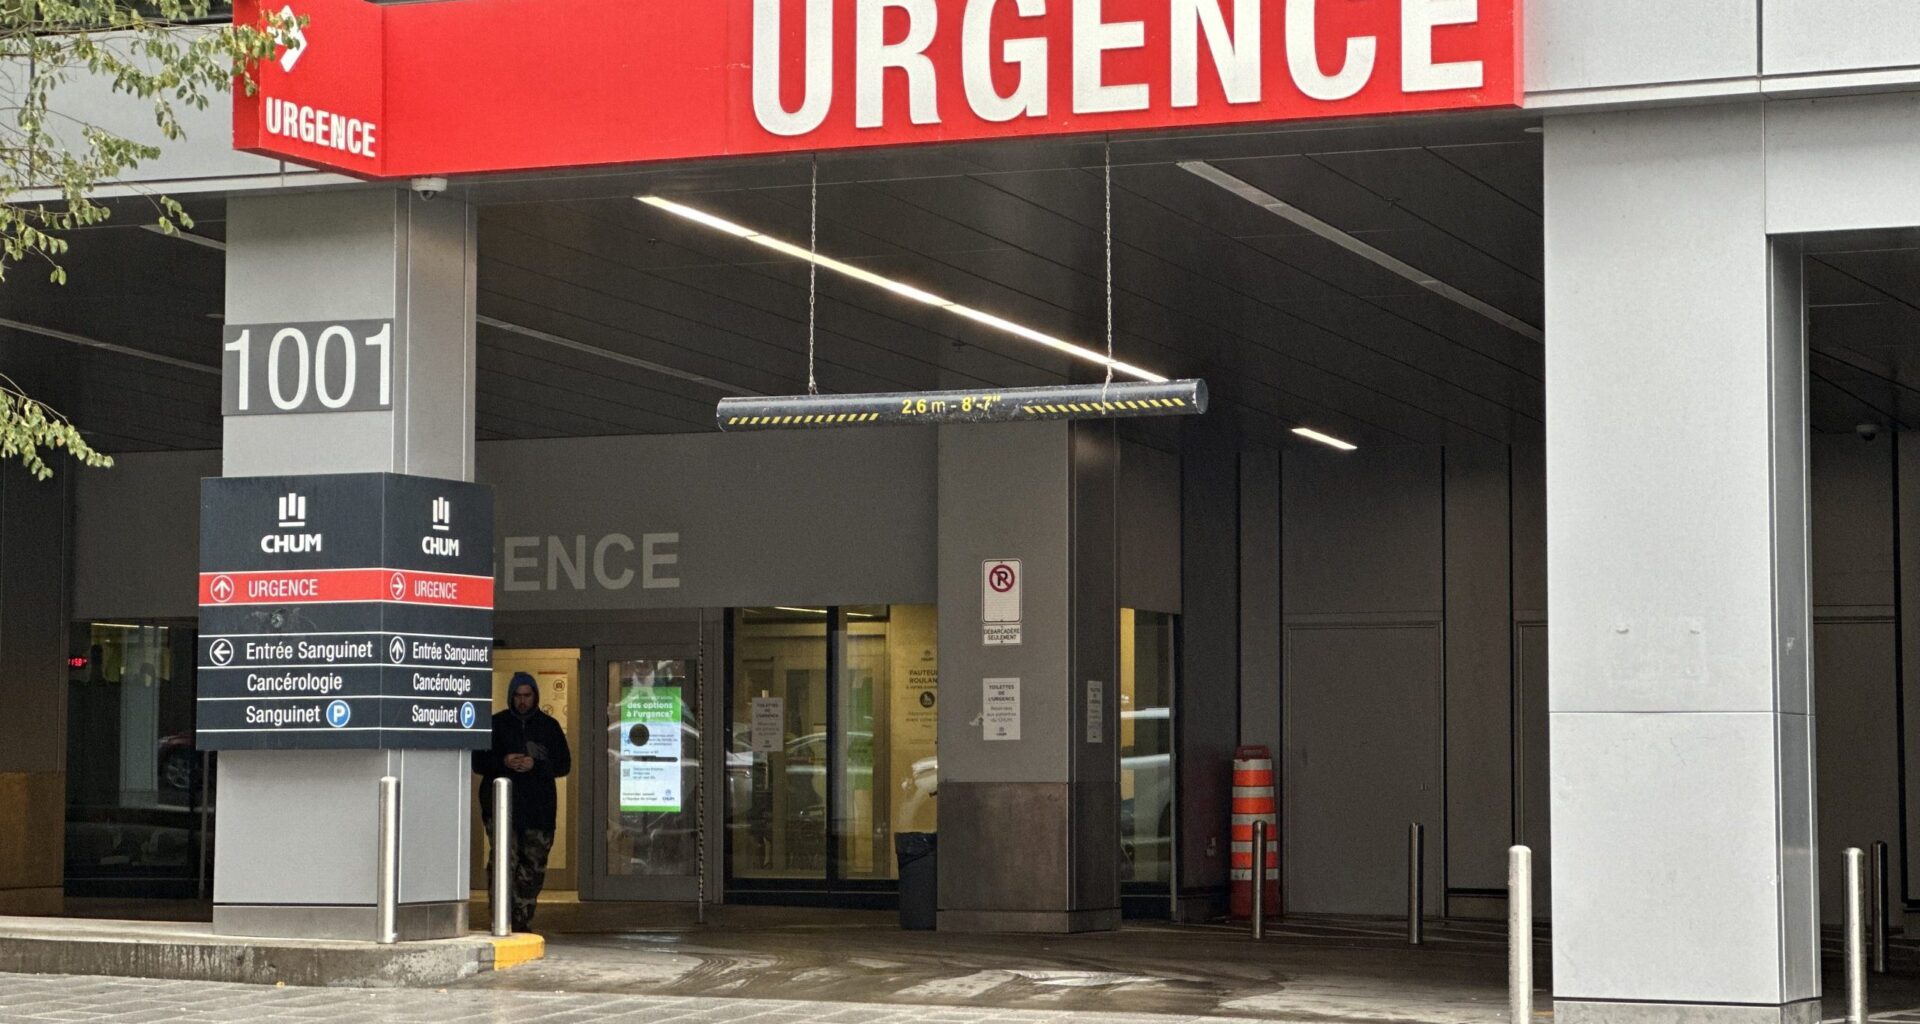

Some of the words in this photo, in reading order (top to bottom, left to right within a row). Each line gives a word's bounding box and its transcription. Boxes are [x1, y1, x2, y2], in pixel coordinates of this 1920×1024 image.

[752, 0, 1485, 137] URGENCE
[265, 97, 376, 159] URGENCE
[225, 322, 391, 411] 1001
[902, 398, 926, 415] 2,6
[931, 401, 946, 413] m
[260, 533, 322, 553] CHUM
[421, 536, 460, 557] CHUM
[493, 532, 680, 592] ENCE
[247, 578, 319, 598] URGENCE
[414, 580, 457, 600] URGENCE
[246, 641, 293, 660] Entrée
[297, 641, 373, 662] Sanguinet
[412, 641, 442, 661] Entrée
[444, 643, 488, 665] Sanguinet
[247, 673, 343, 697] Cancérologie
[412, 673, 471, 695] Cancérologie
[246, 704, 321, 726] Sanguinet
[412, 704, 458, 726] Sanguinet
[633, 710, 674, 719] l'urgence?
[643, 702, 673, 710] options
